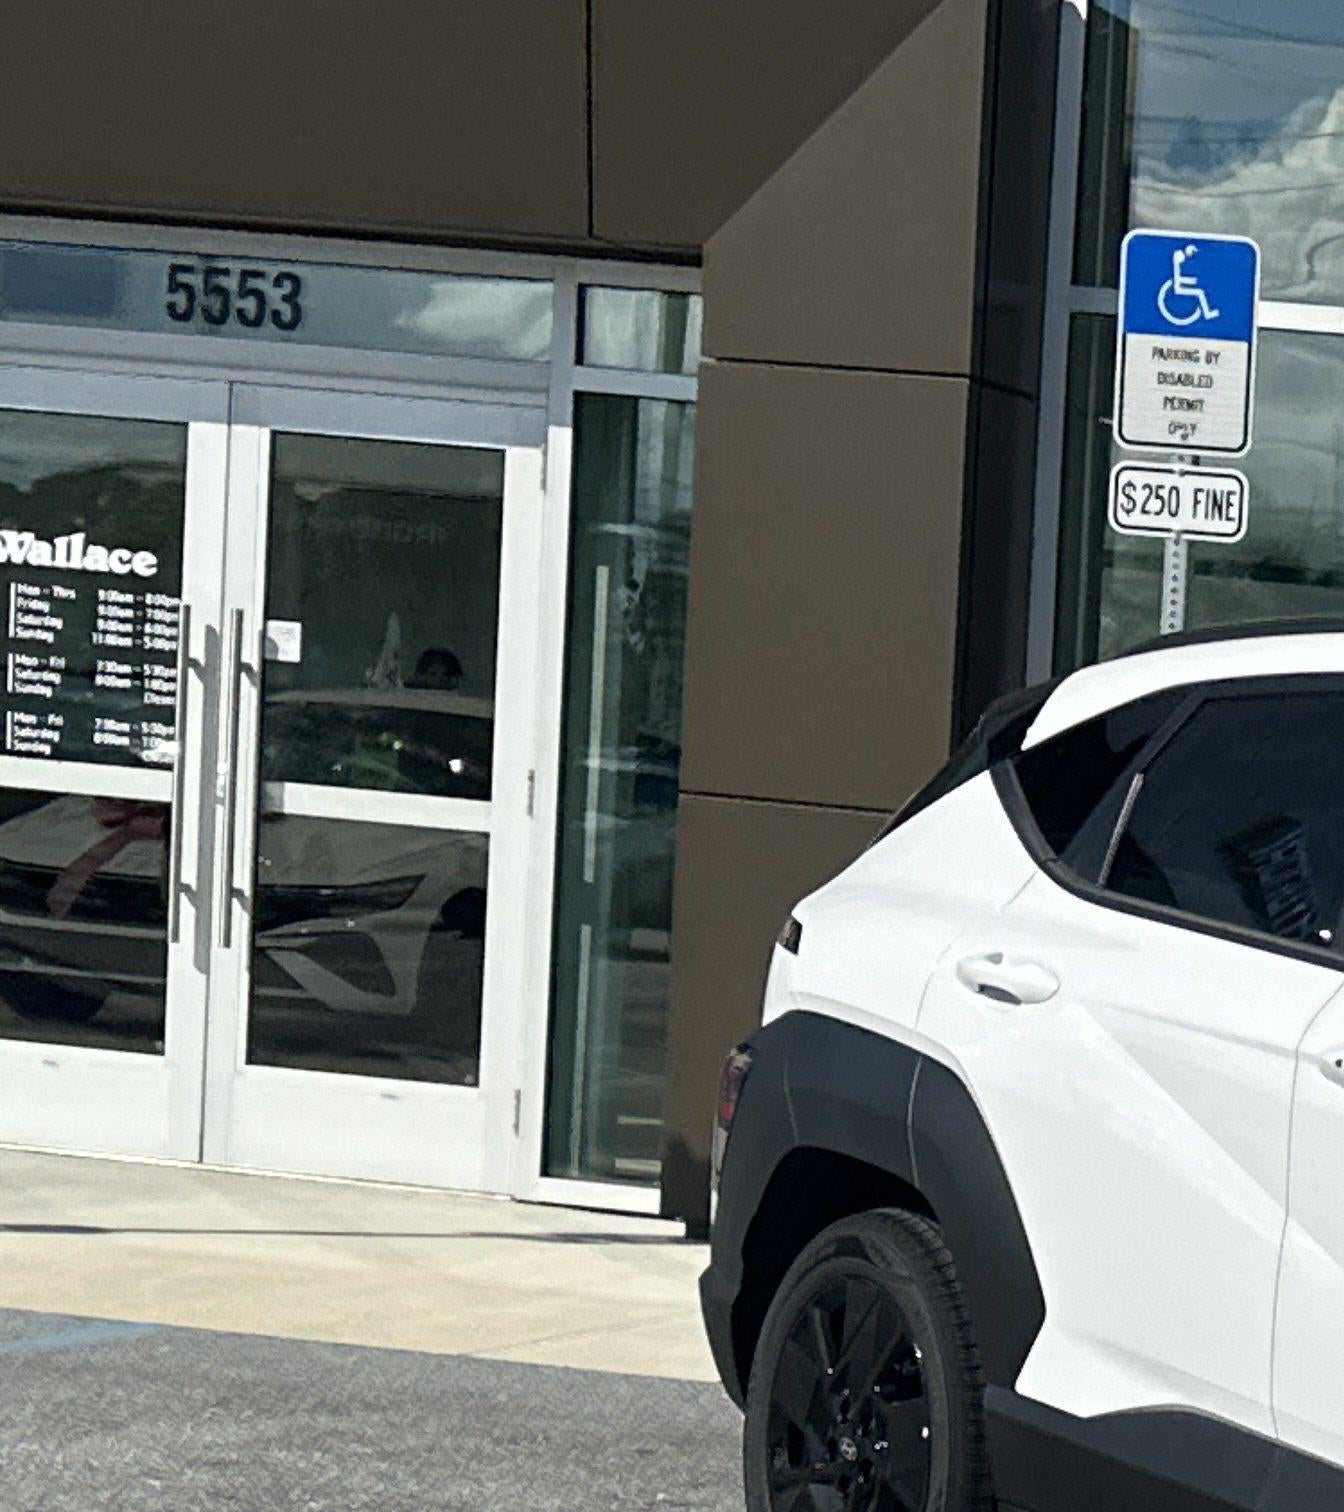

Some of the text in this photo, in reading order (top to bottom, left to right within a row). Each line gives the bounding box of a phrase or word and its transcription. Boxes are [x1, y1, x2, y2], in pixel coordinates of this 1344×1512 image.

[165, 262, 303, 331] 5553
[1205, 350, 1221, 365] BY
[1120, 479, 1237, 523] $250 FINE
[0, 529, 158, 577] Wallace
